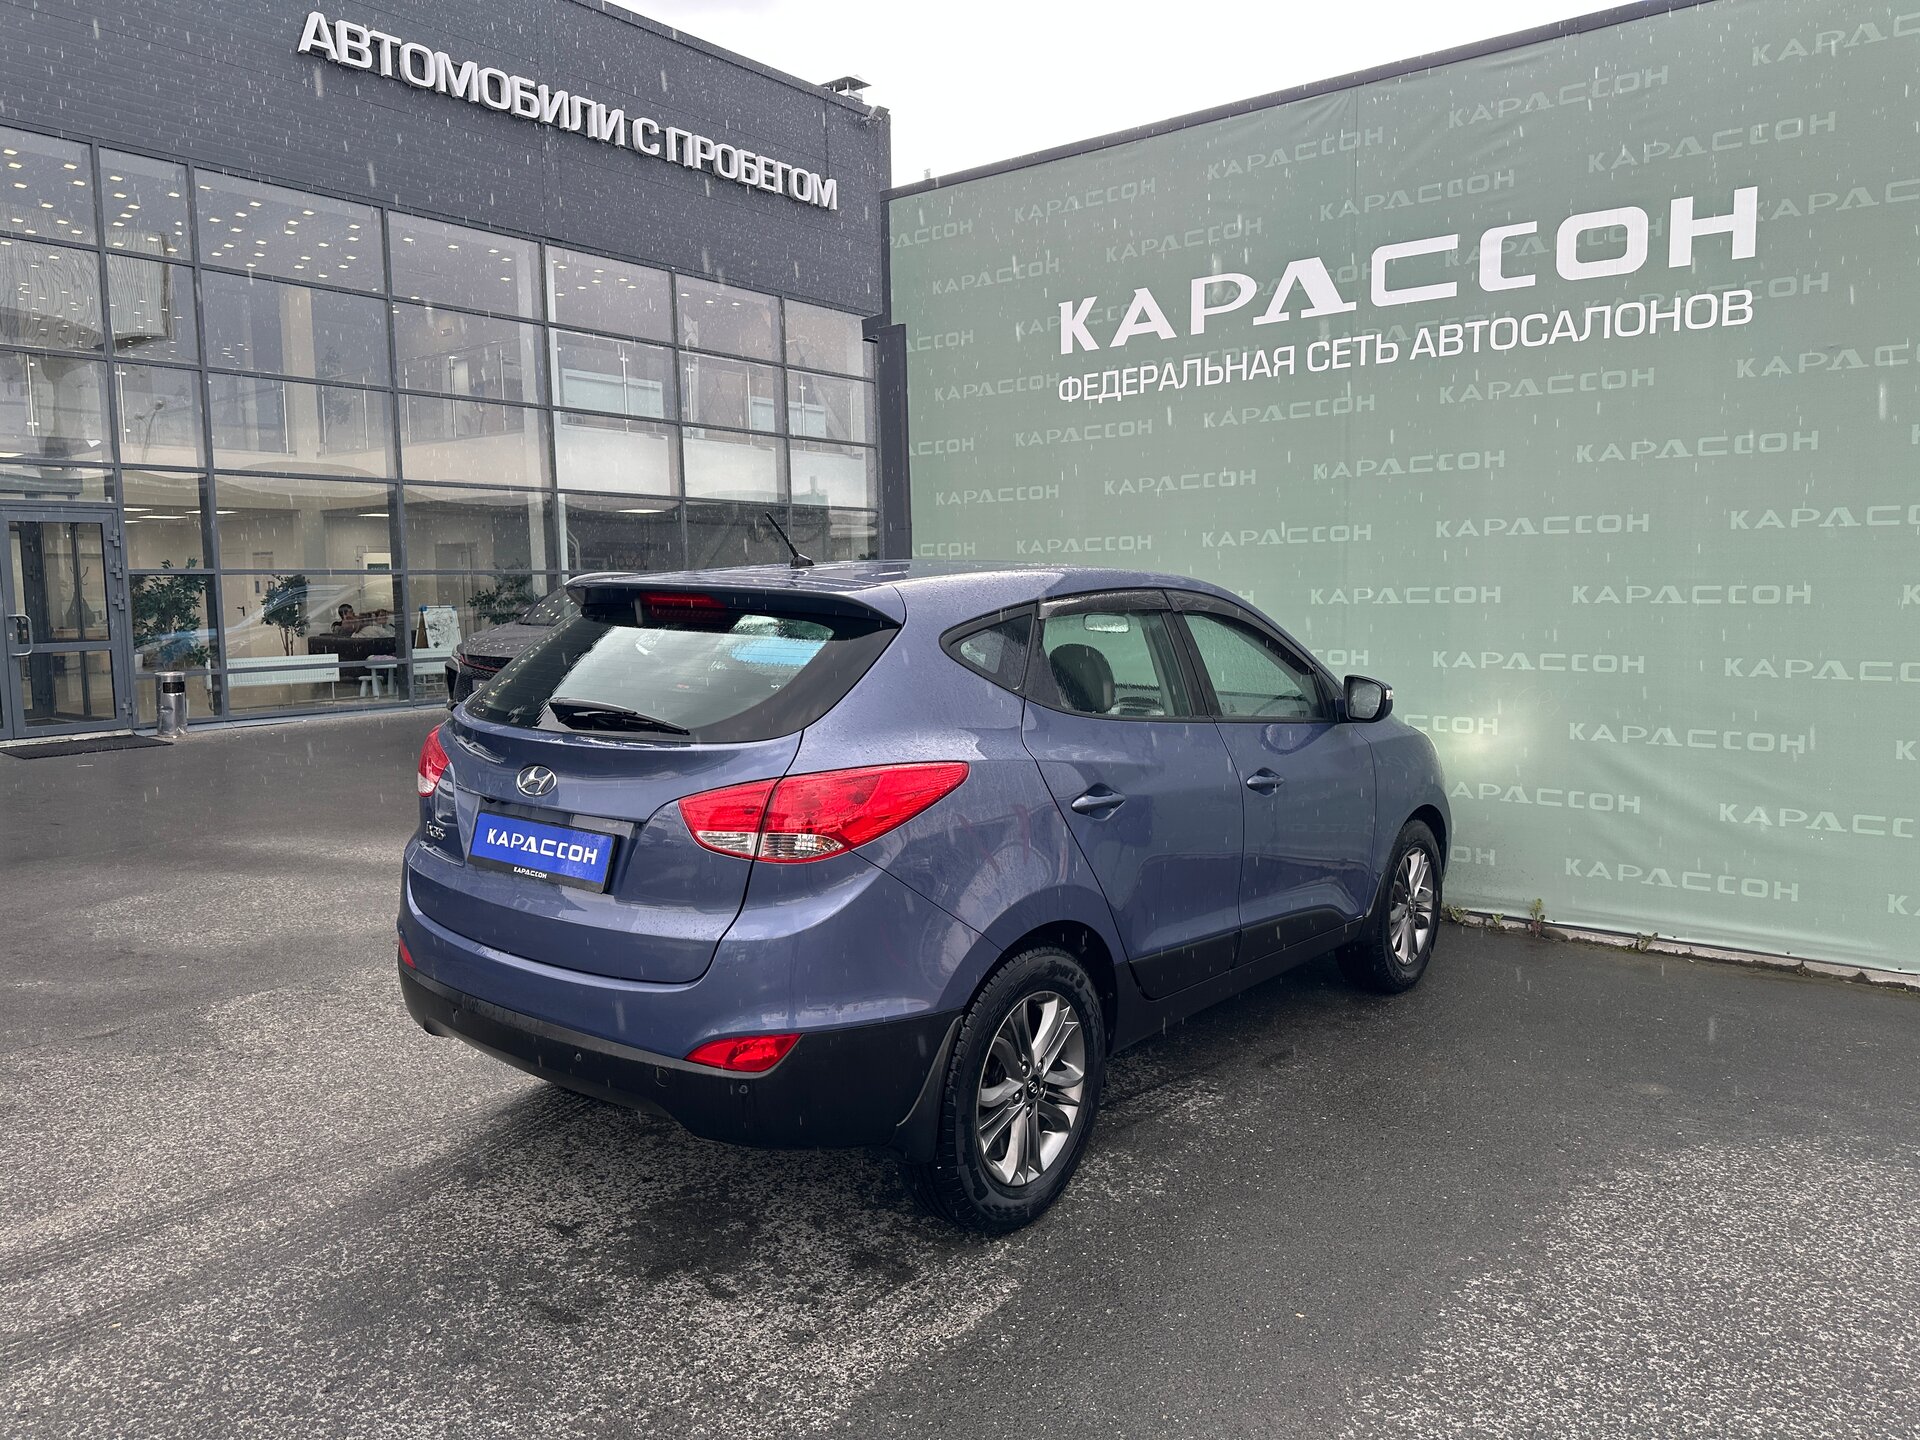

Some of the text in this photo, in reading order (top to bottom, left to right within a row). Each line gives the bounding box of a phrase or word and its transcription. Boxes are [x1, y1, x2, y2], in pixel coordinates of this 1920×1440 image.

[298, 12, 838, 210] АВТОМОБИЛИ С ПРОБЕГОМ
[1448, 65, 1669, 129] КАРАССОН
[1207, 126, 1384, 181] КАРАССОН
[1588, 111, 1836, 173] КАРАССОН
[1014, 178, 1156, 224] КАРАССОН
[1319, 169, 1515, 222] КАРАССОН
[889, 218, 973, 249] АССОН
[1106, 217, 1262, 263] КАРАССОН
[933, 257, 1060, 295] КАРАССОН
[1058, 186, 1757, 355] КАРАССОН
[1058, 289, 1754, 403] ФЕДЕРАЛЬНАЯ СЕТЬ АВТОСАЛОНОВ
[1736, 343, 1920, 379] КАРАС
[1440, 368, 1655, 404] КАРАССОН
[1204, 394, 1375, 428] КАРАССОН
[1015, 419, 1152, 447] КАРАССОН
[1577, 430, 1819, 463] КАРАССОН
[1313, 450, 1505, 480] КАРАССОН
[936, 484, 1059, 506] КАРАССОН
[1105, 469, 1256, 495] КАРАССОН
[1202, 524, 1371, 547] КАРАССОН
[1436, 514, 1649, 538] КАРАССОН
[1017, 535, 1151, 554] КАРАССОН
[1311, 586, 1501, 605] КАРАССОН
[1572, 585, 1811, 605] КАРАССОН
[1433, 651, 1645, 674] КАРАССОН
[1569, 722, 1805, 753] КАРАССОН
[1450, 781, 1640, 814] АРАССОН
[487, 828, 598, 865] КАРАССОН
[514, 866, 547, 879] КАРАССОН
[1565, 858, 1799, 902] КАРАССОН
